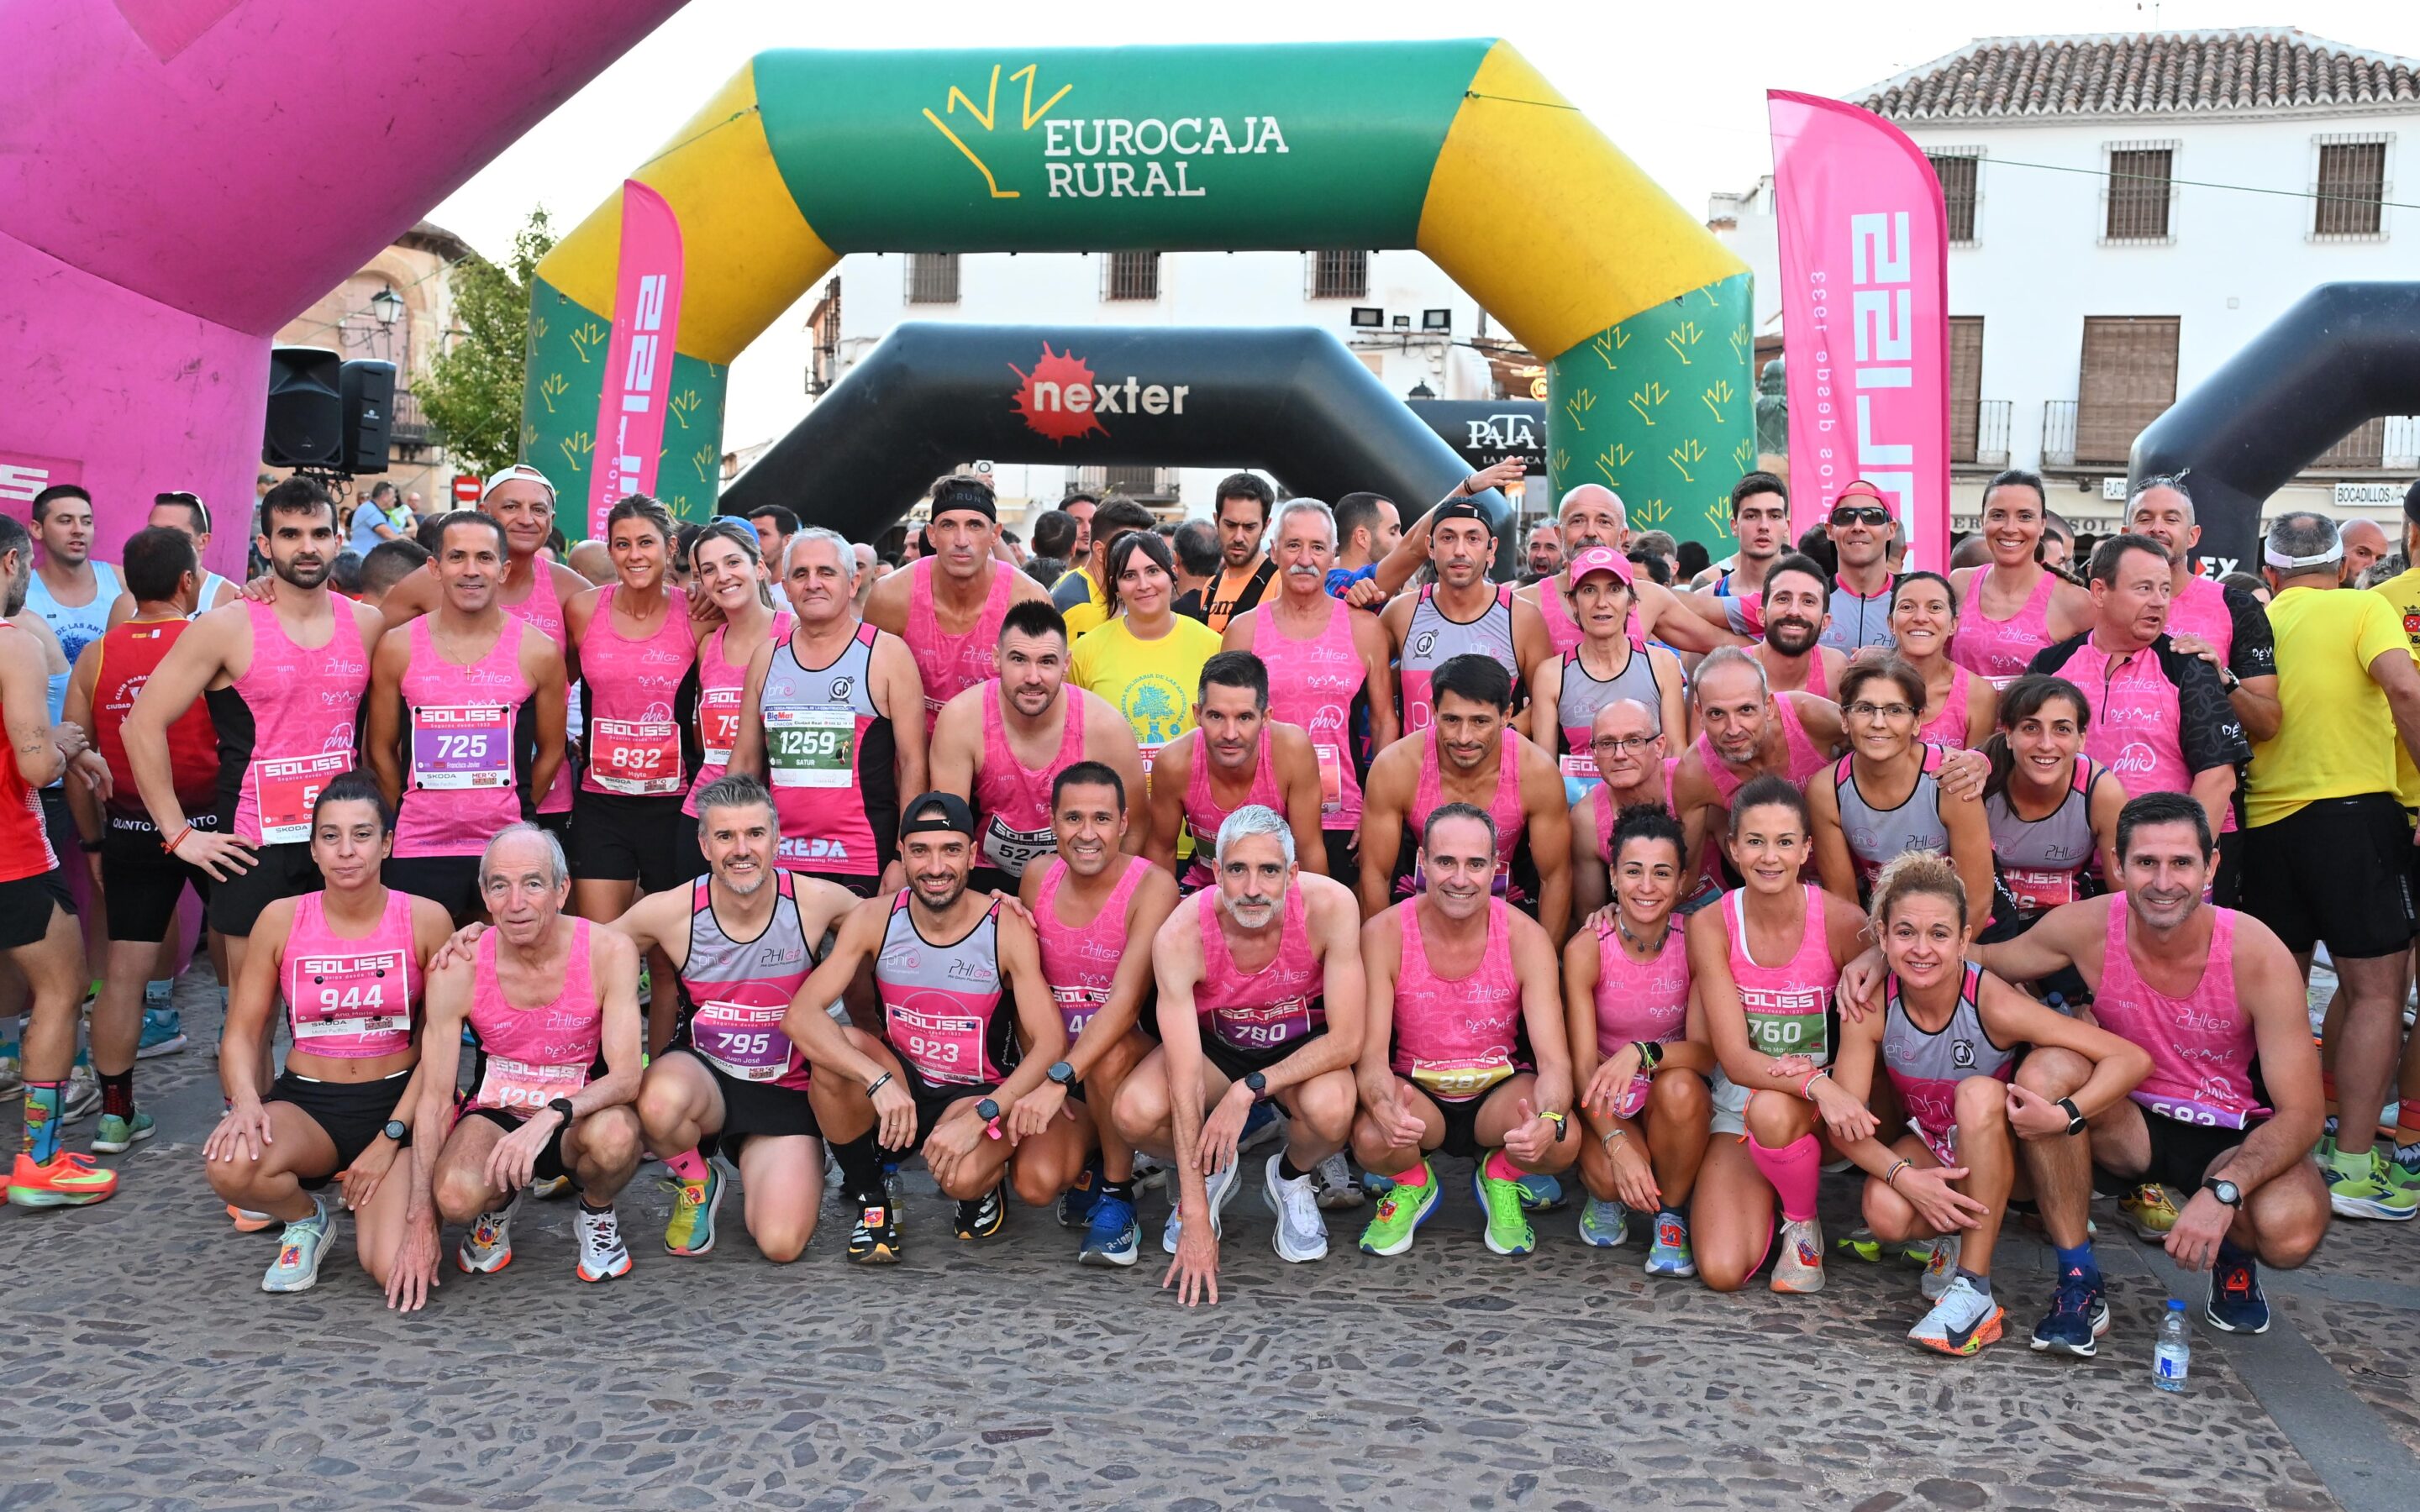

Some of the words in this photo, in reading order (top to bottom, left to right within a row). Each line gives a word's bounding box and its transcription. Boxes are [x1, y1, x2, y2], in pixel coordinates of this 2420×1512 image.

[1044, 116, 1289, 156] EUROCAJA
[1045, 161, 1206, 197] RURAL
[1034, 376, 1189, 415] nexter
[1466, 414, 1539, 449] PATA
[2106, 482, 2127, 496] PLATO
[2338, 486, 2390, 502] BOCADILLOS
[2071, 519, 2112, 531] SOL
[68, 622, 85, 631] LAS
[963, 645, 992, 661] PHIG
[115, 683, 128, 700] CLUB
[1125, 674, 1154, 692] SOLIDARIA
[1165, 675, 1176, 686] LAS
[708, 692, 741, 704] SOL
[421, 710, 501, 722] SOLISS
[766, 711, 794, 721] BigMat
[600, 723, 671, 736] SOLISS
[718, 715, 739, 737] 79
[437, 734, 487, 759] 725
[780, 731, 835, 754] 1259
[613, 747, 661, 768] 832
[265, 757, 343, 777] SOLISS
[113, 817, 151, 832] QUINTO
[780, 837, 847, 858] REDA
[305, 956, 394, 974] SOLISS
[320, 984, 384, 1012] 944
[703, 1007, 786, 1021] SOLISS
[894, 1011, 974, 1032] SOLISS
[1219, 1004, 1299, 1021] SOLISS
[1234, 1023, 1286, 1042] 780
[1748, 1019, 1802, 1043] 760
[718, 1032, 770, 1054] 795
[910, 1036, 959, 1063] 923
[497, 1062, 578, 1078] SOLISS
[1438, 1073, 1492, 1089] 287
[1106, 1231, 1134, 1252] R-1000
